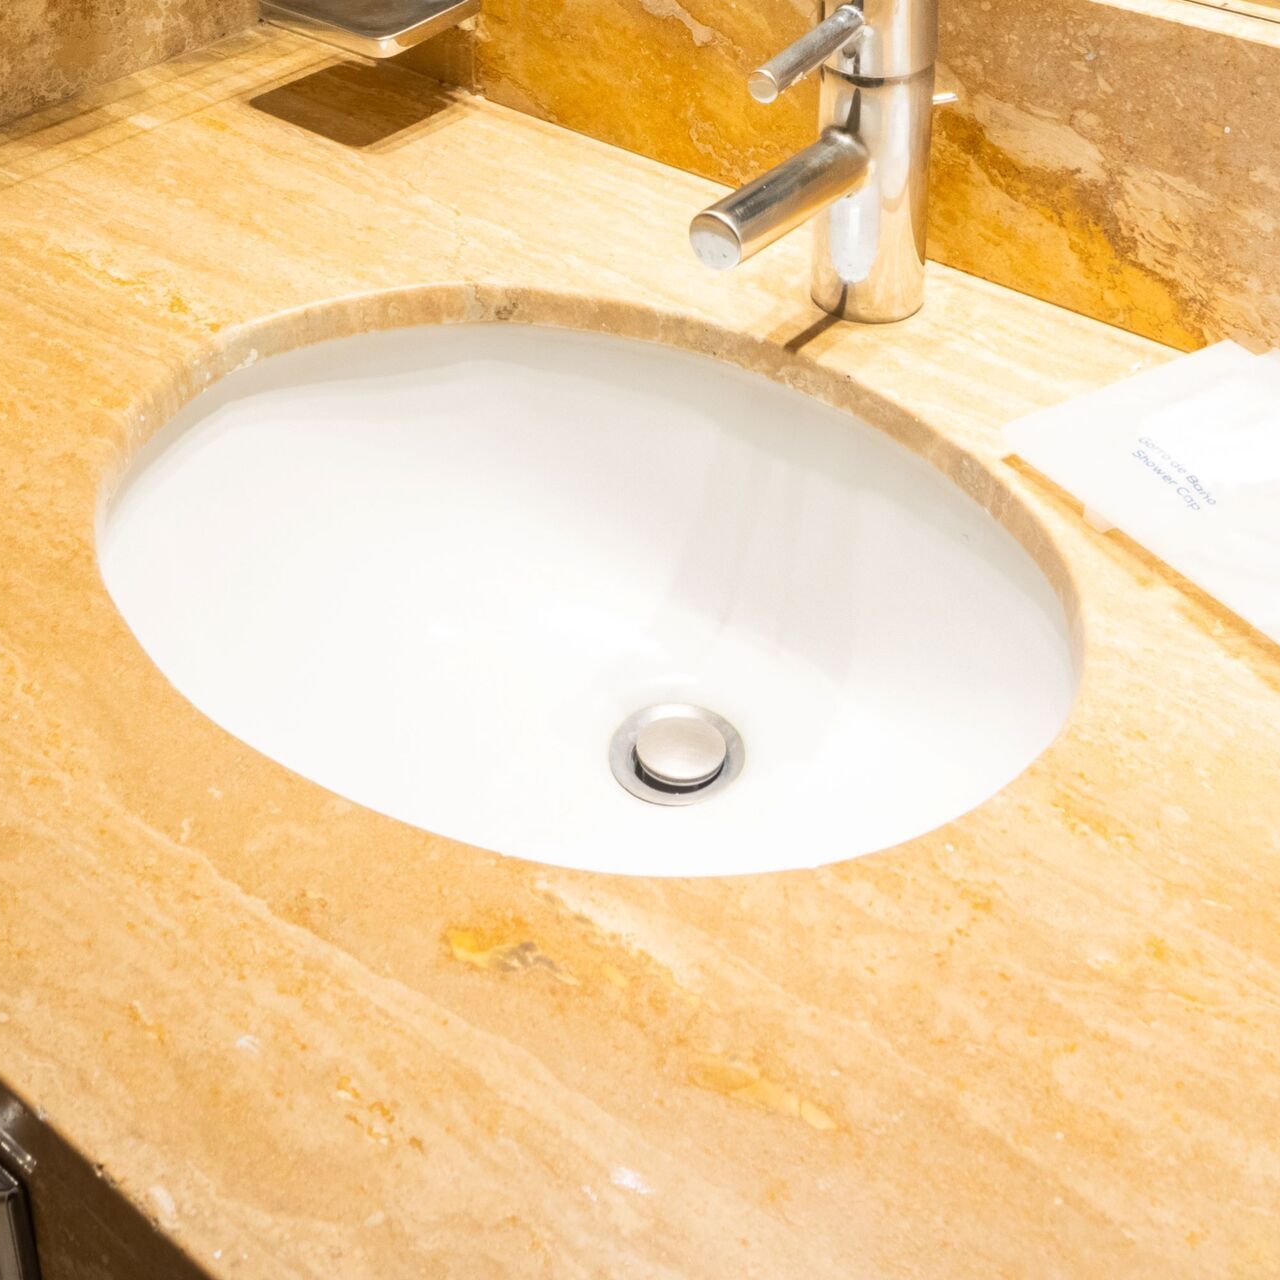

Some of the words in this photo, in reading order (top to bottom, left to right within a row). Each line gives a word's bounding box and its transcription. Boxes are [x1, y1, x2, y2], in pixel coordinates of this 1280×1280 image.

[1132, 450, 1177, 486] Shower
[1176, 487, 1200, 511] Cap
[1170, 461, 1187, 473] de
